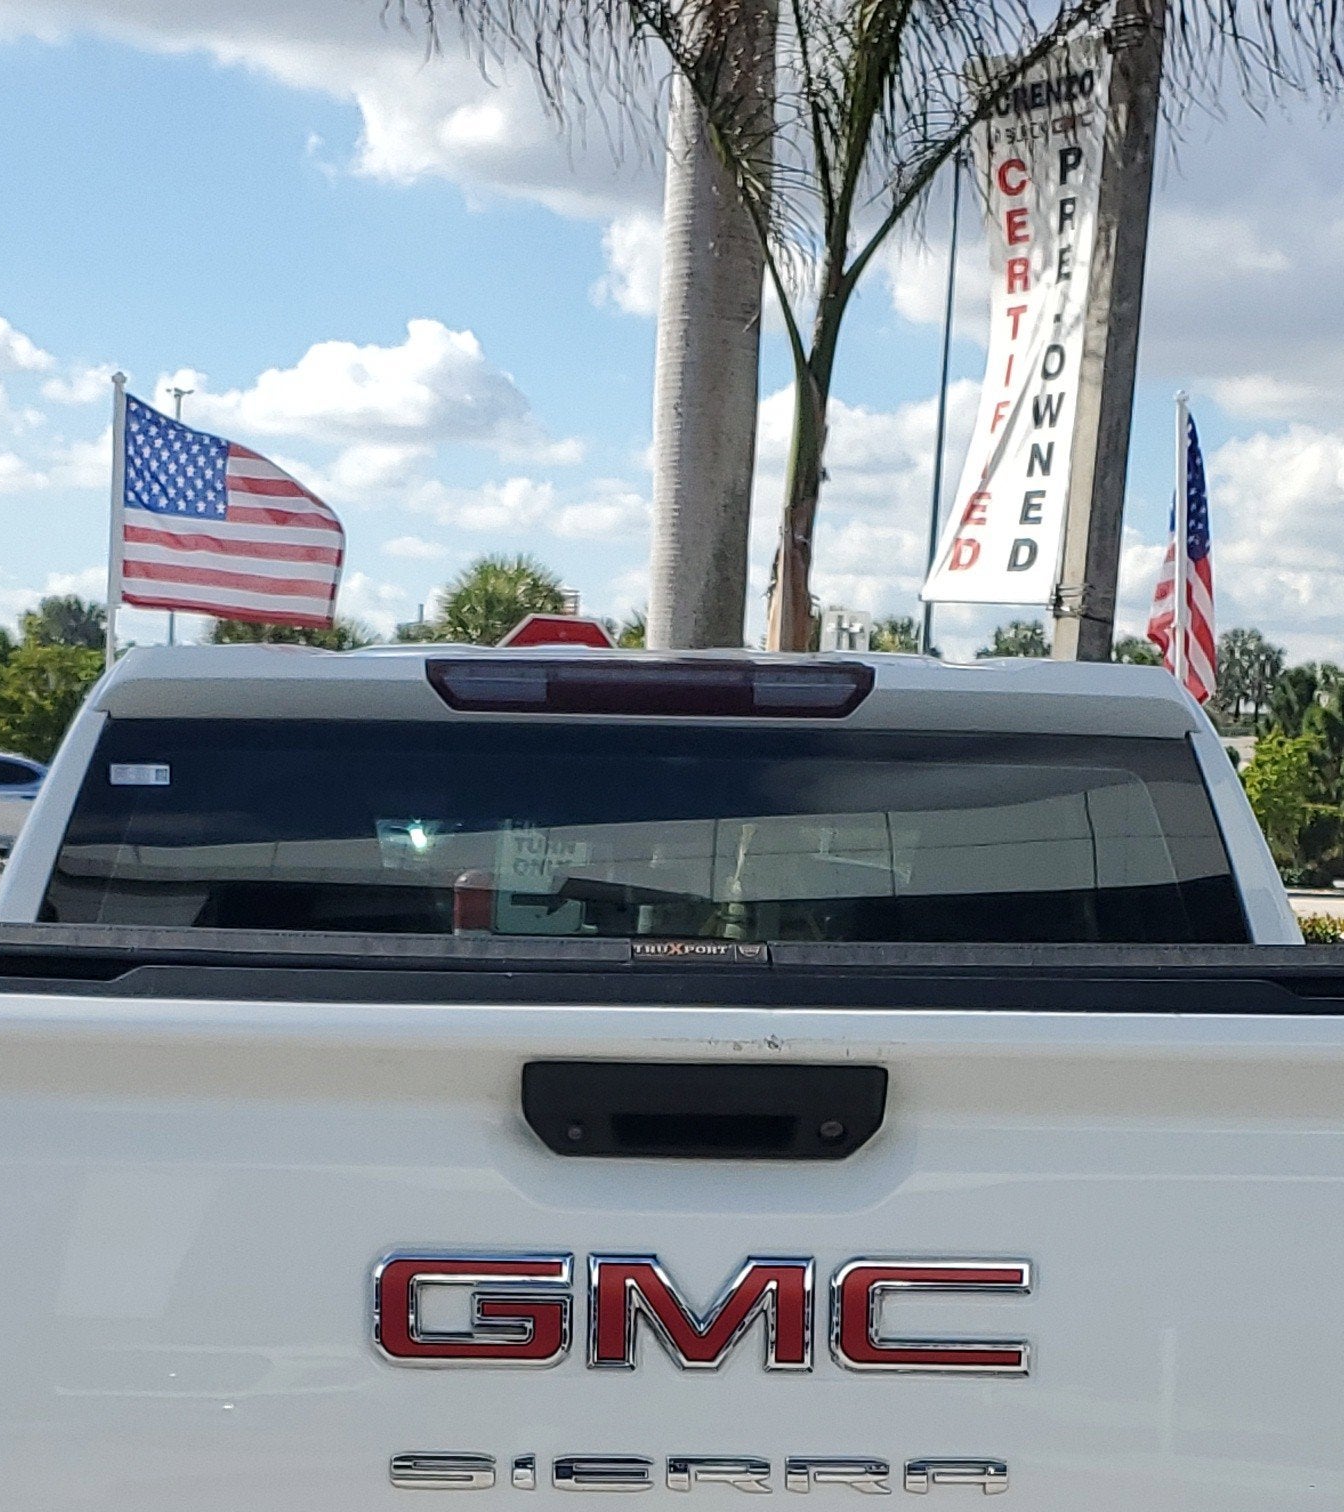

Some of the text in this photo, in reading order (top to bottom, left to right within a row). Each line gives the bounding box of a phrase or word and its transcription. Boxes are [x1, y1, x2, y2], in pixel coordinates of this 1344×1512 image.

[977, 69, 1094, 119] ORENZO
[948, 158, 1030, 571] CERTIFIED
[1007, 147, 1083, 572] PRE-OWNED
[373, 1251, 1032, 1377] GMC
[389, 1450, 1010, 1495] SIERRA
